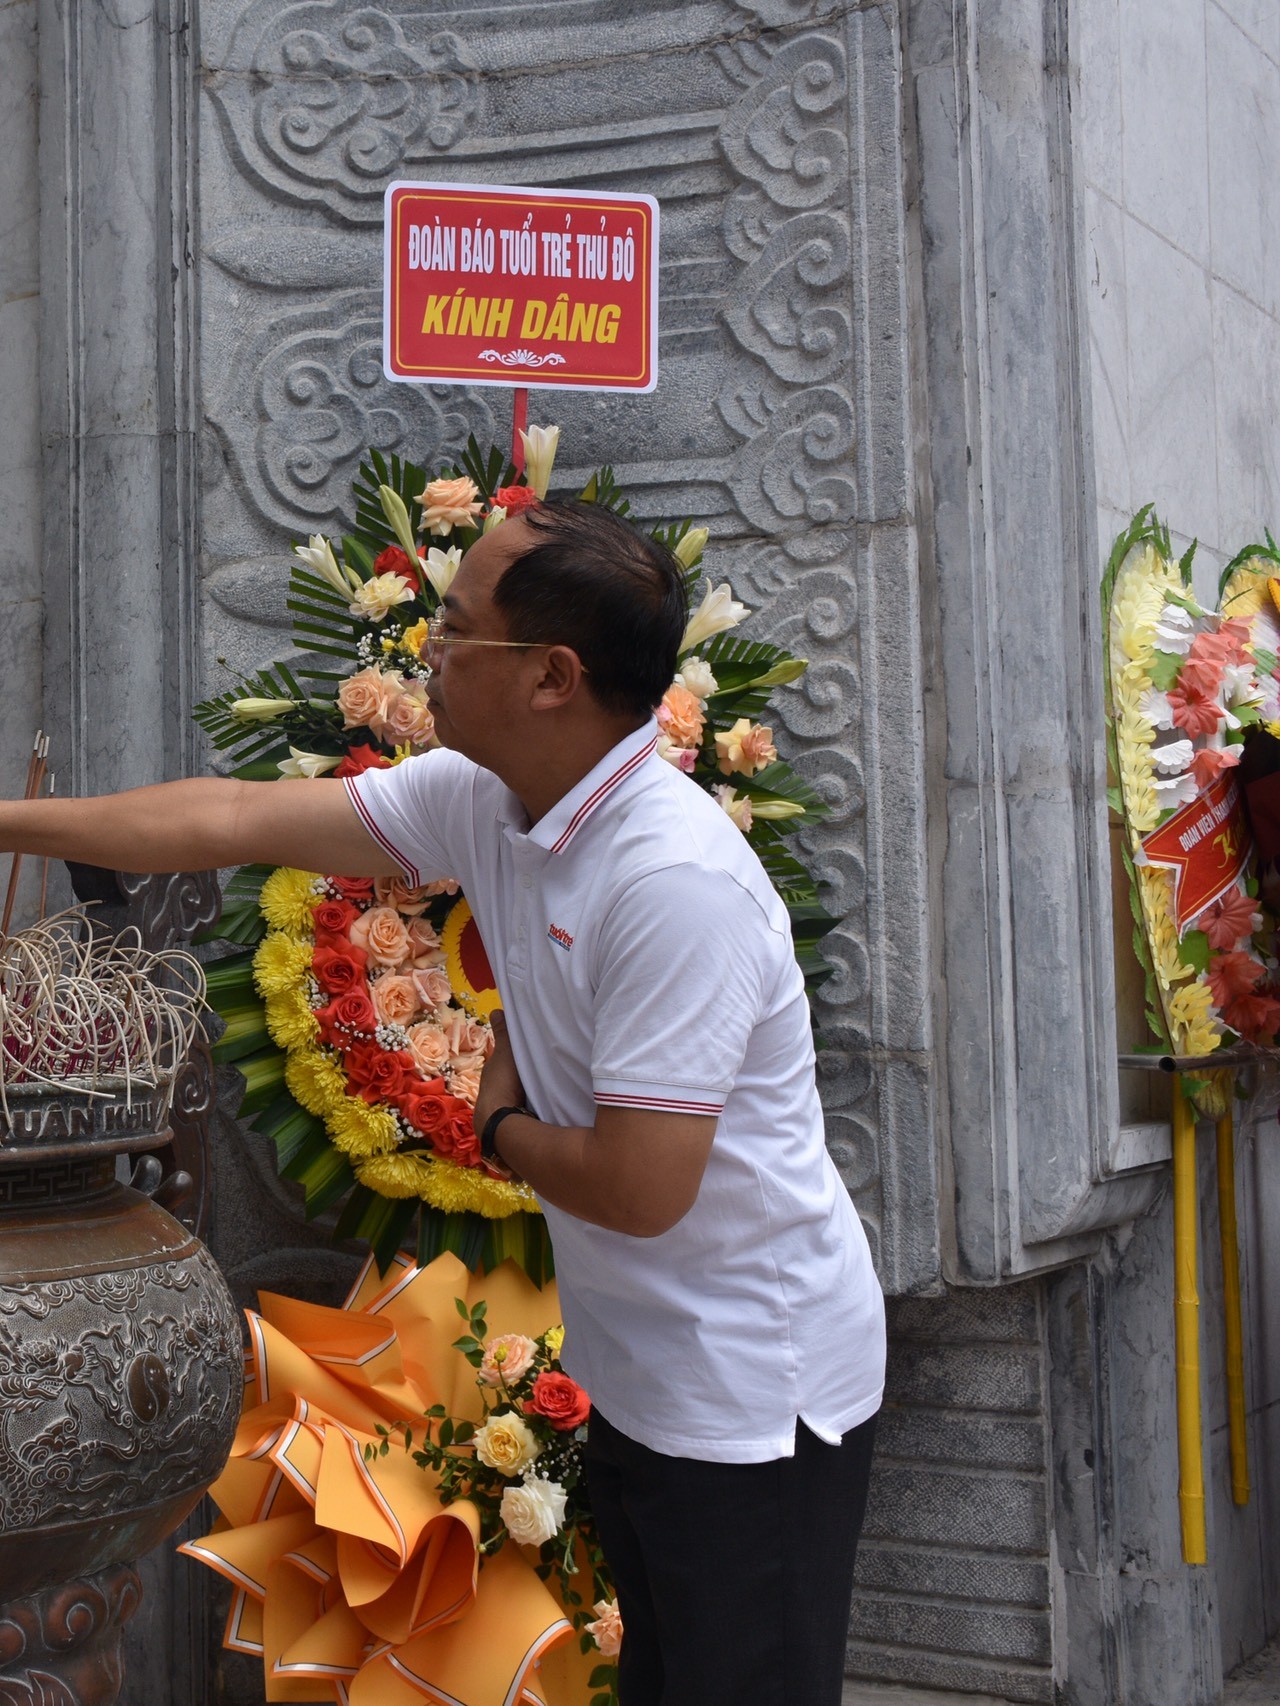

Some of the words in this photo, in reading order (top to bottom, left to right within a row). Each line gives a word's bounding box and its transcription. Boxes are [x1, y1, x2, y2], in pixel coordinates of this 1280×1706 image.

[409, 216, 456, 272] ĐOÀN
[461, 218, 495, 275] BÁO
[500, 212, 537, 276] TUỔI
[542, 213, 572, 278] TRẺ
[577, 215, 608, 280] THỦ
[612, 227, 635, 282] ĐÔ
[421, 288, 514, 338] KÍNH
[520, 293, 621, 344] DÂNG
